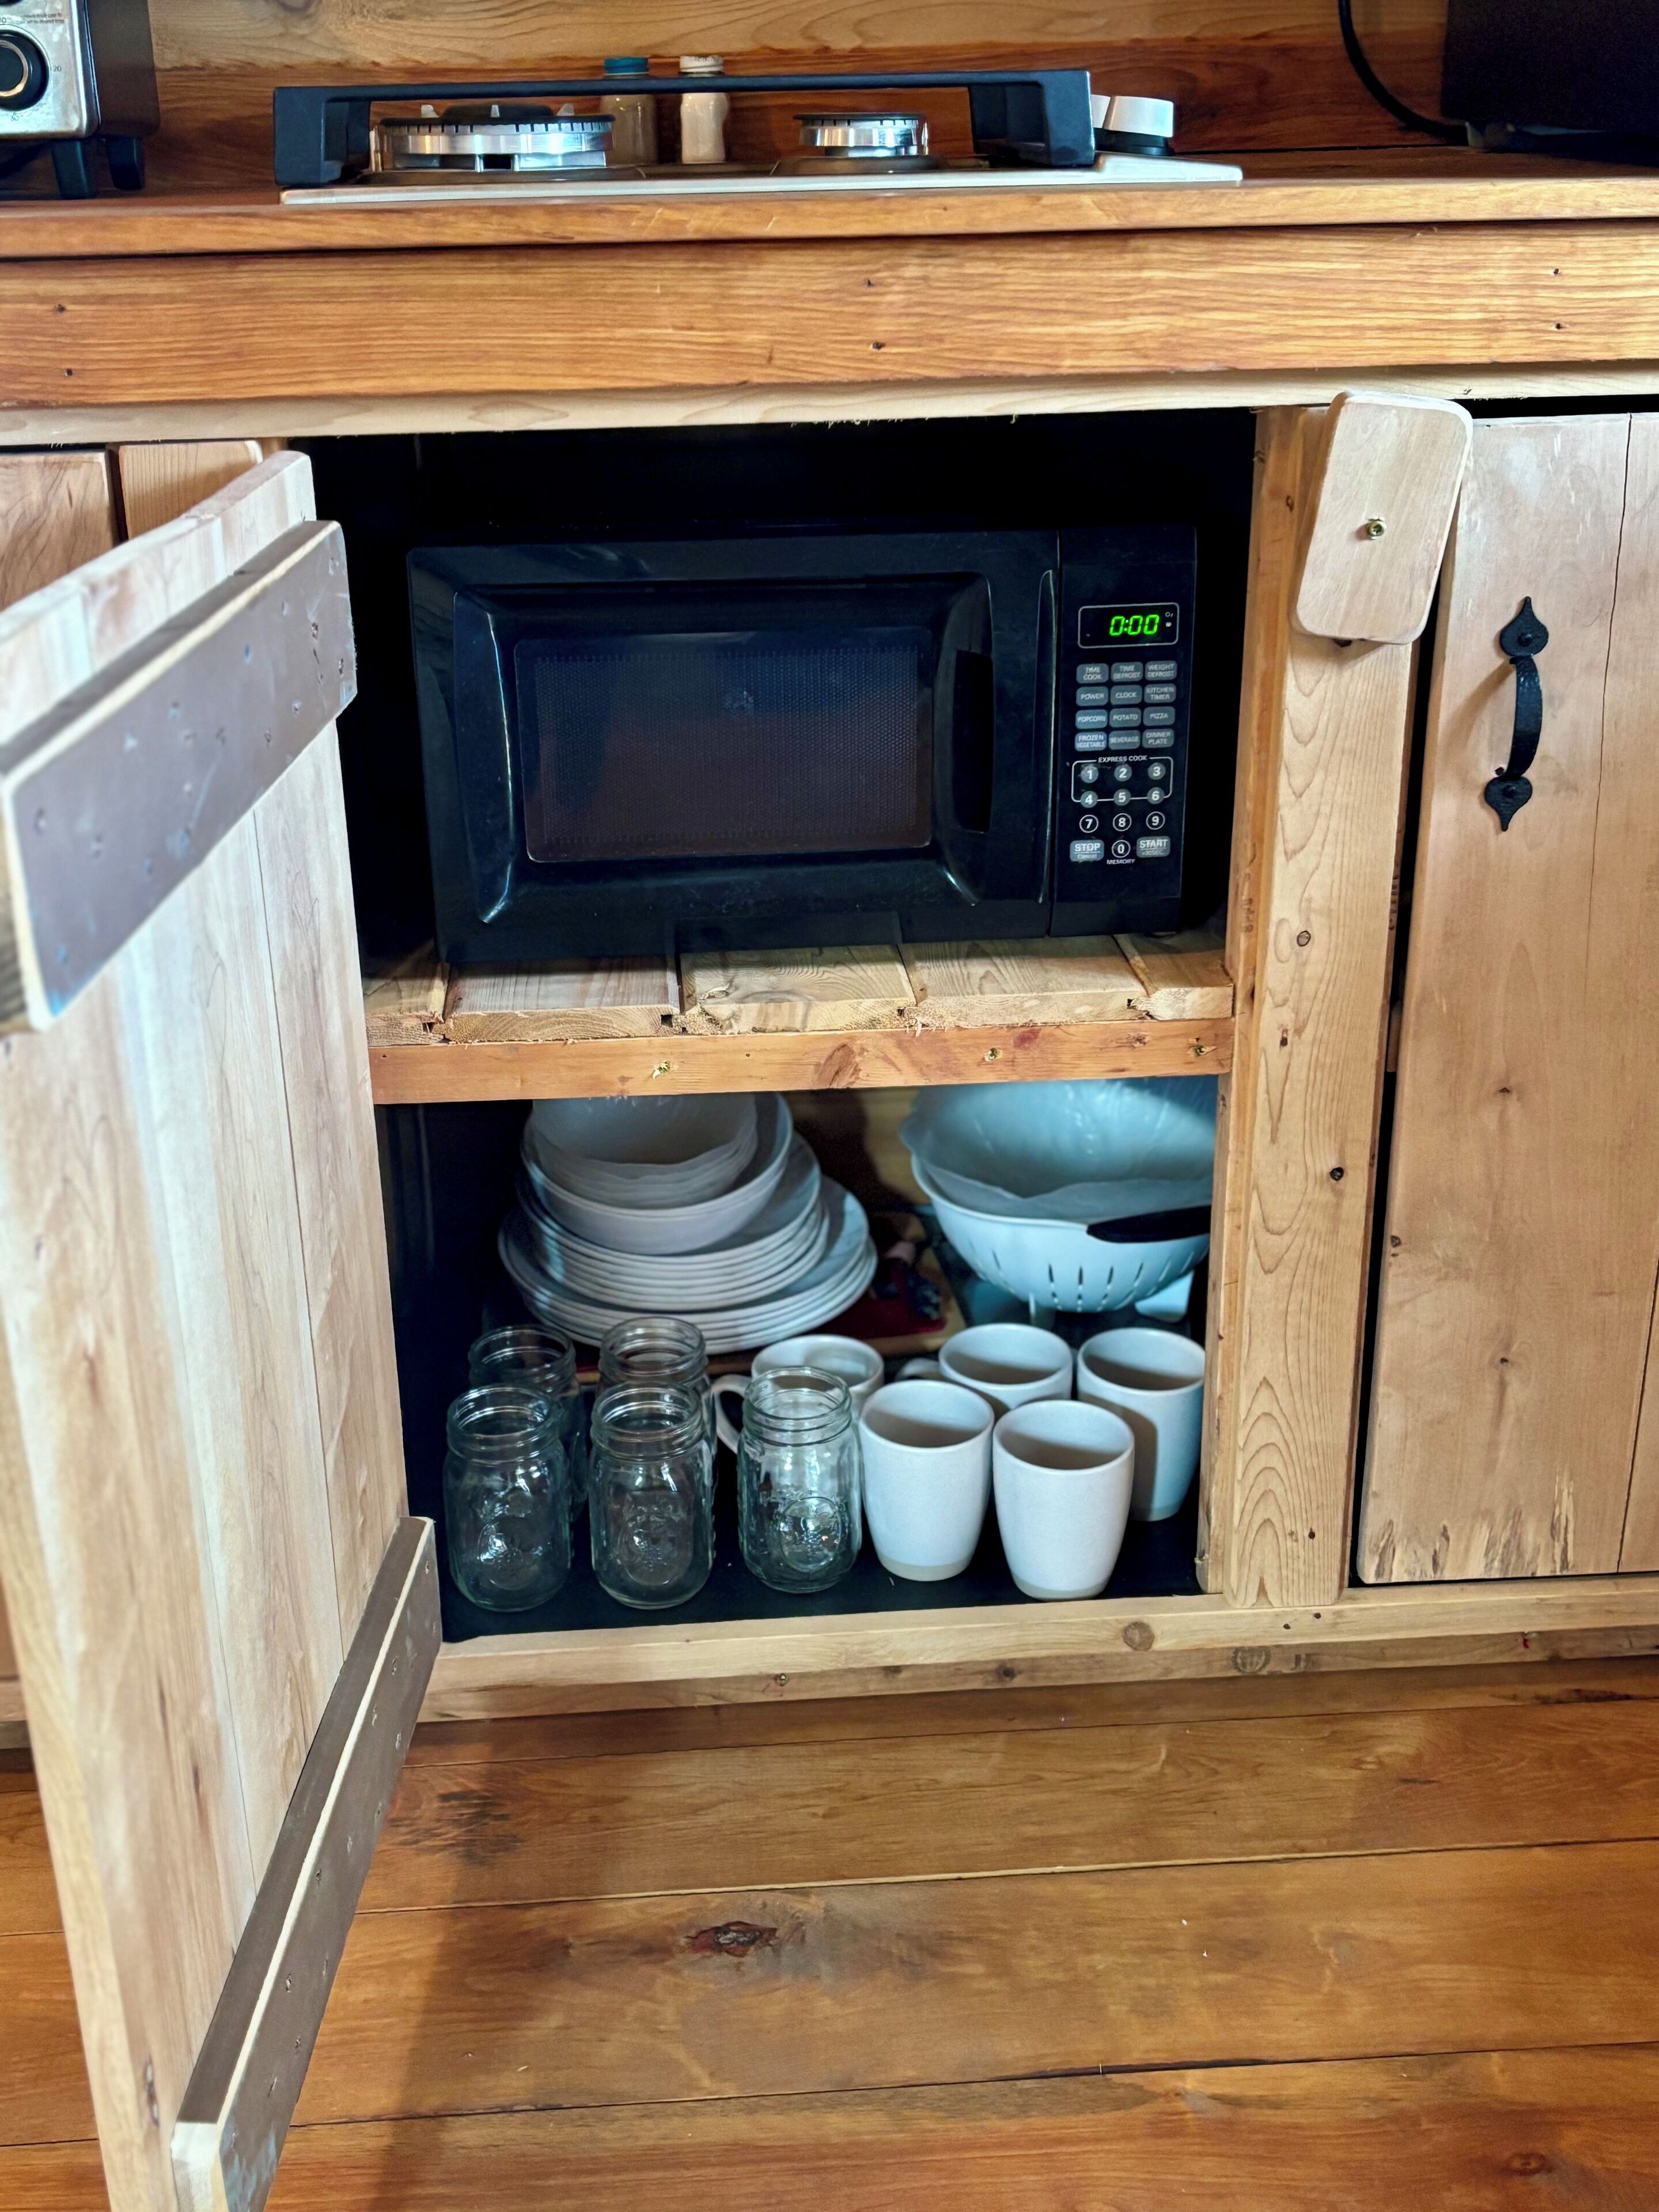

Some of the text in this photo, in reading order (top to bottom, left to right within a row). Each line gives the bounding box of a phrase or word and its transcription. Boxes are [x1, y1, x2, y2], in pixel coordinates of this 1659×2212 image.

[1109, 614, 1160, 636] 0:00
[1087, 770, 1092, 779] 1
[1119, 768, 1127, 778] 2
[1153, 767, 1161, 776] 3
[1085, 794, 1093, 804] 4
[1118, 792, 1126, 802] 5
[1152, 791, 1160, 801] 6
[1085, 819, 1093, 829] 7
[1118, 817, 1126, 827] 8
[1152, 816, 1159, 825] 9
[1075, 843, 1100, 851] STOP
[1139, 839, 1169, 848] START
[1118, 844, 1124, 854] 0
